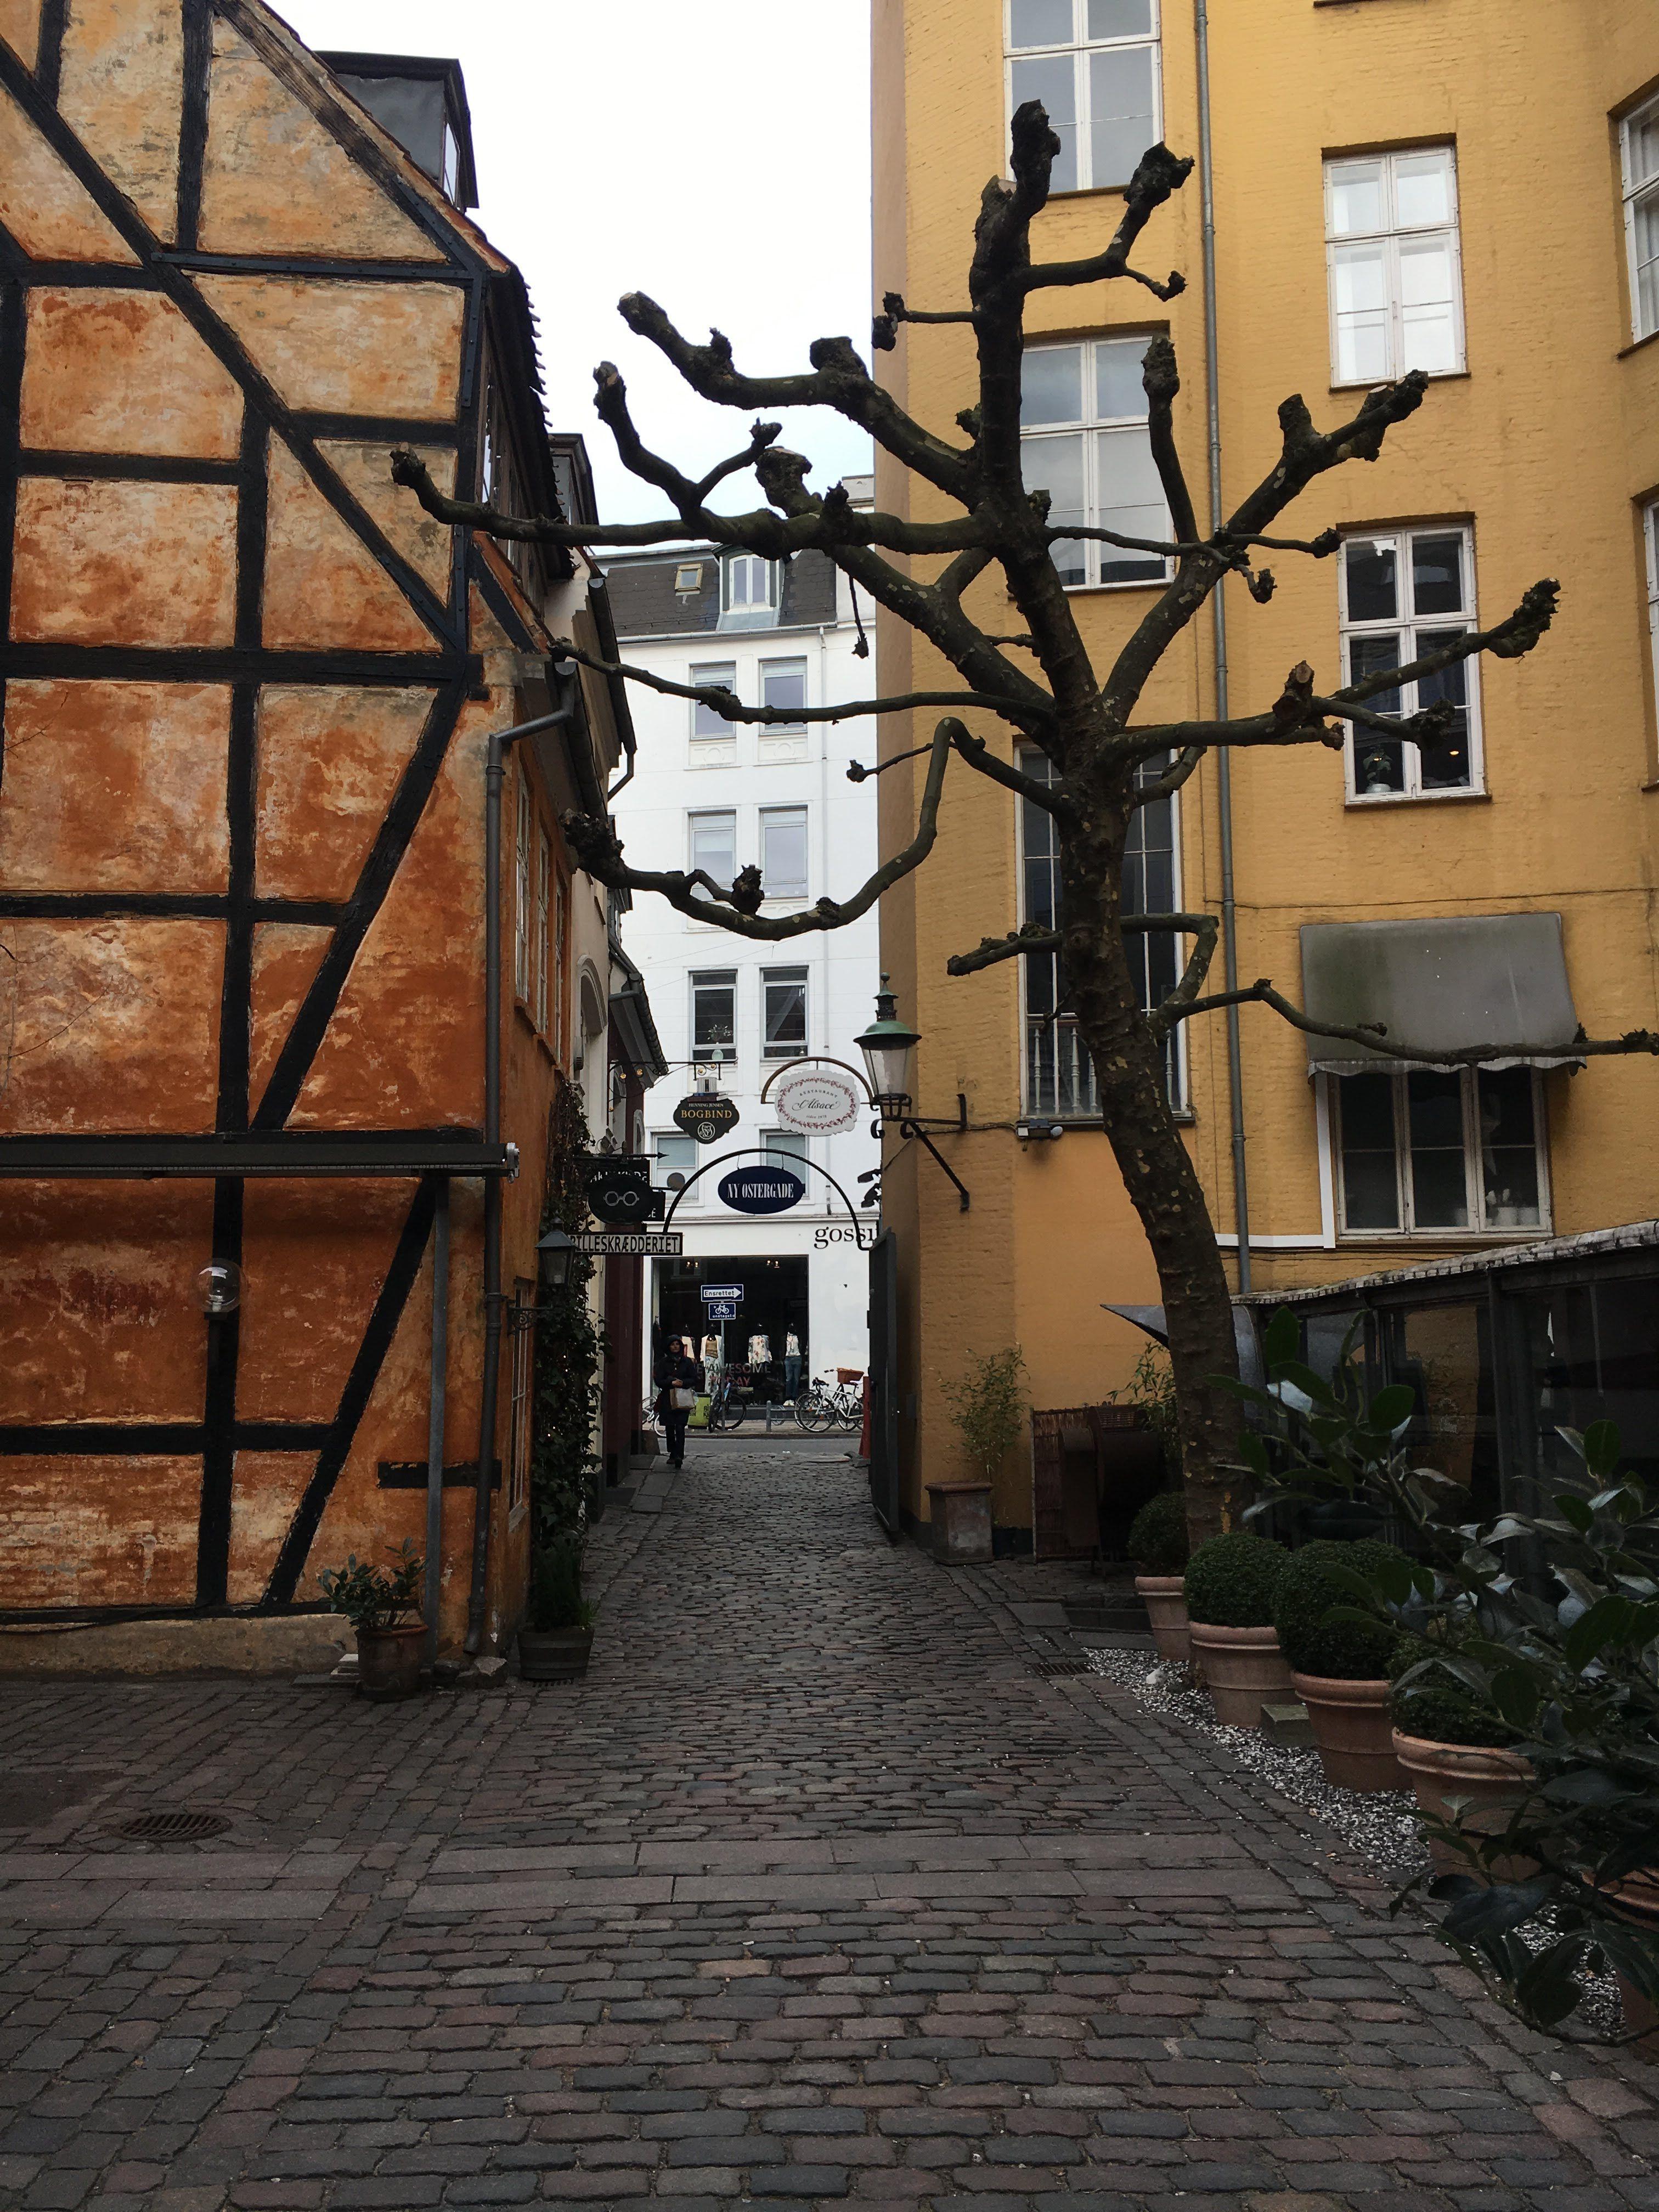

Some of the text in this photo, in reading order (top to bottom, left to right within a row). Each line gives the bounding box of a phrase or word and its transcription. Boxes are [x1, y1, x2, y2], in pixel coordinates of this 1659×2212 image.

[799, 1090, 838, 1098] RESTAURANT
[681, 1110, 732, 1118] BOGBIND
[727, 1183, 740, 1198] NY
